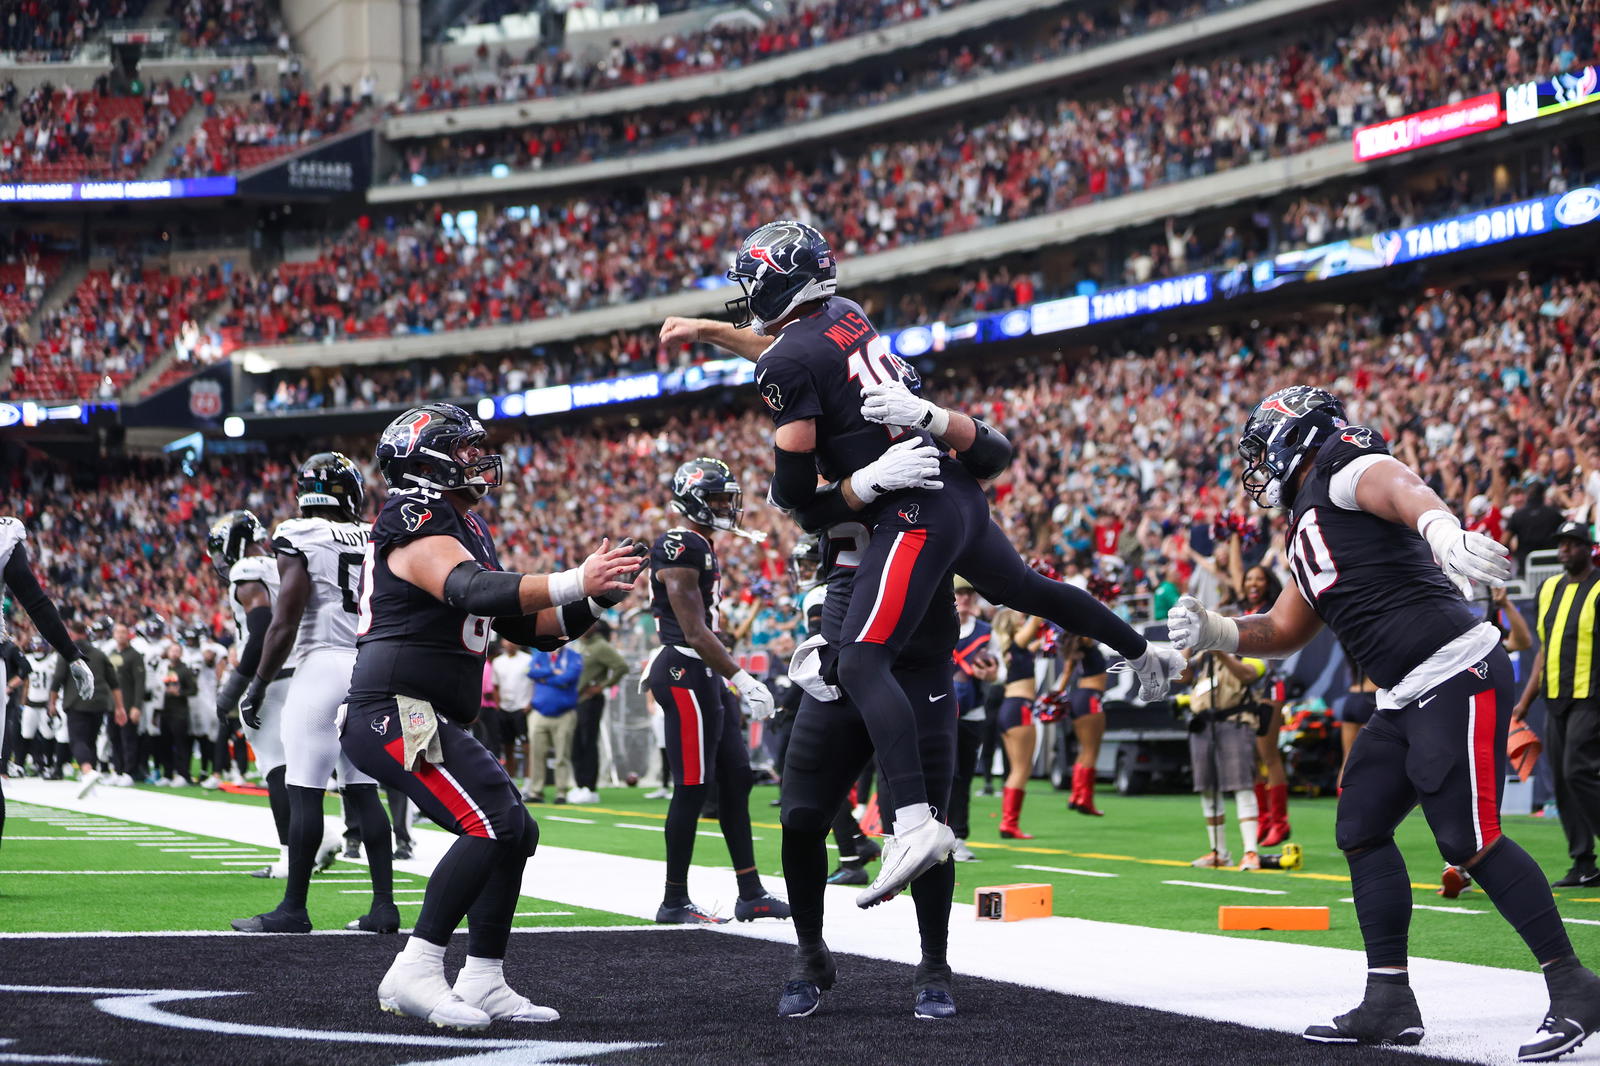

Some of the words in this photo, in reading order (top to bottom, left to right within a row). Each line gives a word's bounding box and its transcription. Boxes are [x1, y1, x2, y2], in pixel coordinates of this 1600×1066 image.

[1405, 220, 1460, 257] TAKE
[1475, 202, 1545, 243] DRIVE
[1092, 288, 1137, 320] TAKE
[1148, 275, 1207, 310] DRIVE
[824, 312, 870, 351] MILLS
[303, 496, 329, 505] JAGUARS
